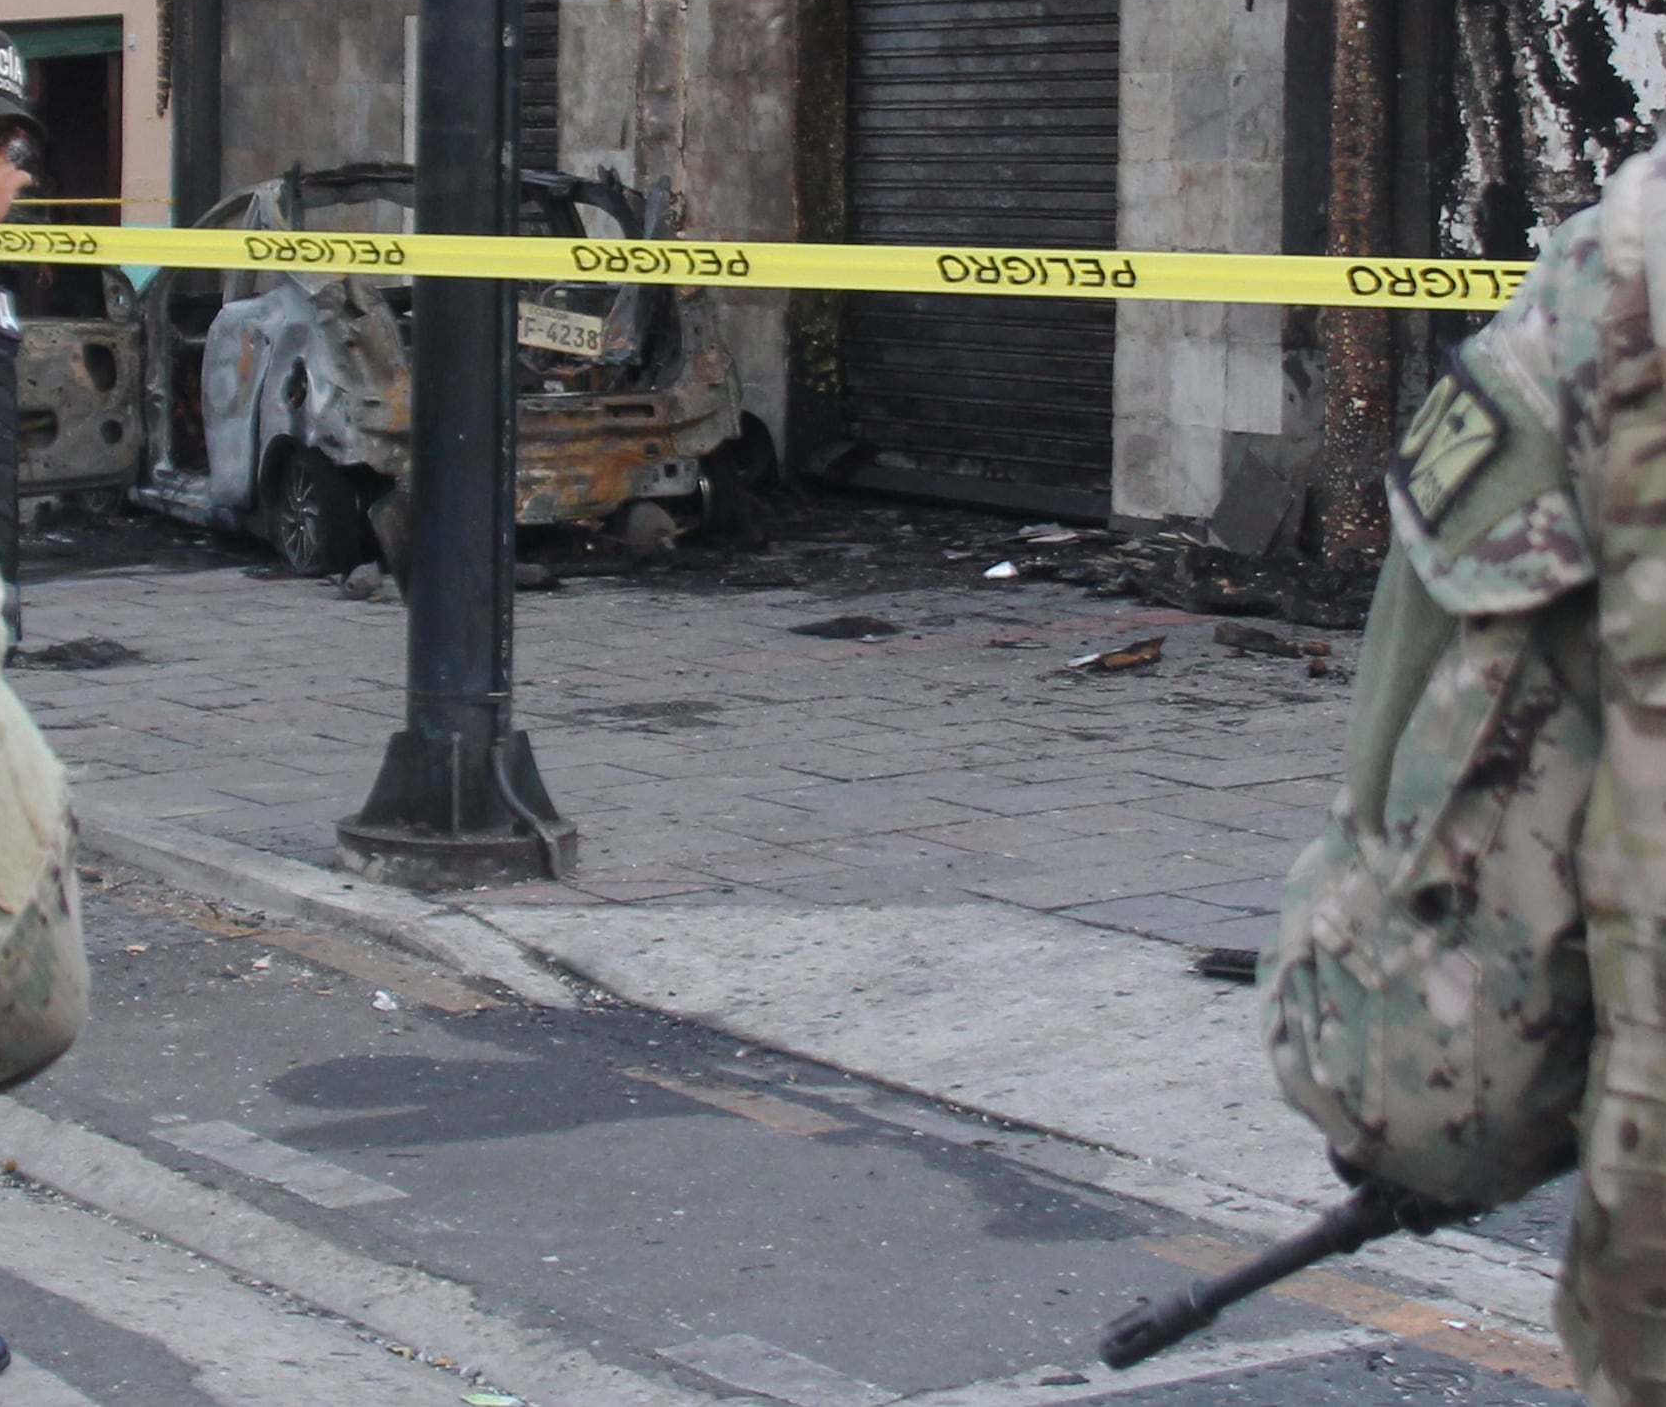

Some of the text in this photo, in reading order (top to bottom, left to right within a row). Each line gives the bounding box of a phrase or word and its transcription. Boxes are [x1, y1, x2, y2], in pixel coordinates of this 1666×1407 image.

[245, 236, 406, 266] PELIGRO
[570, 245, 750, 277] PELIGRO
[936, 254, 1137, 289] PELIGRO
[1346, 265, 1530, 301] ELIGRO
